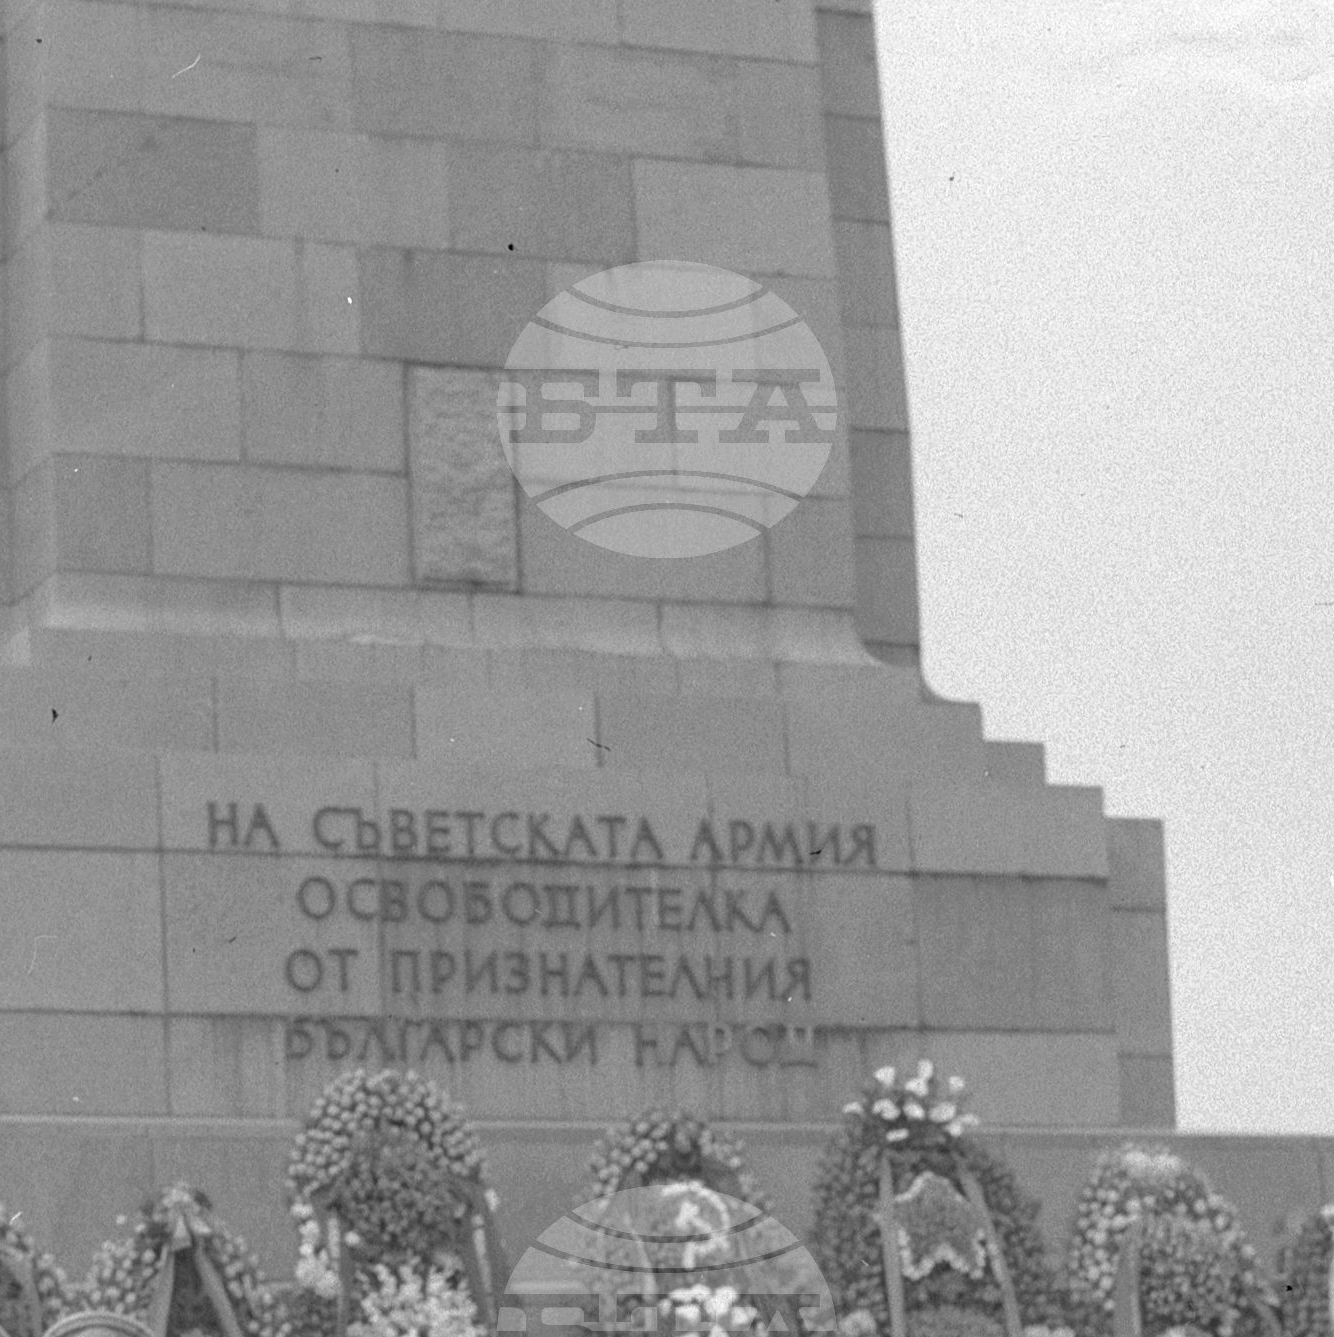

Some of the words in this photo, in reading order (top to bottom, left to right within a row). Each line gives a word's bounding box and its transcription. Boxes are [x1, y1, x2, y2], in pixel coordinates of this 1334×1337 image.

[206, 802, 280, 849] НА
[312, 806, 665, 860] СЪВЕТСКАТА
[689, 819, 877, 866] АРМИЯ
[296, 876, 792, 935] ОСВОБОДИТЕЛКА
[284, 948, 360, 993] ОТ
[391, 949, 813, 1001] ПРИЗНАТЕЛНИЯ
[285, 1017, 597, 1066] БЪЛГАРСКИ
